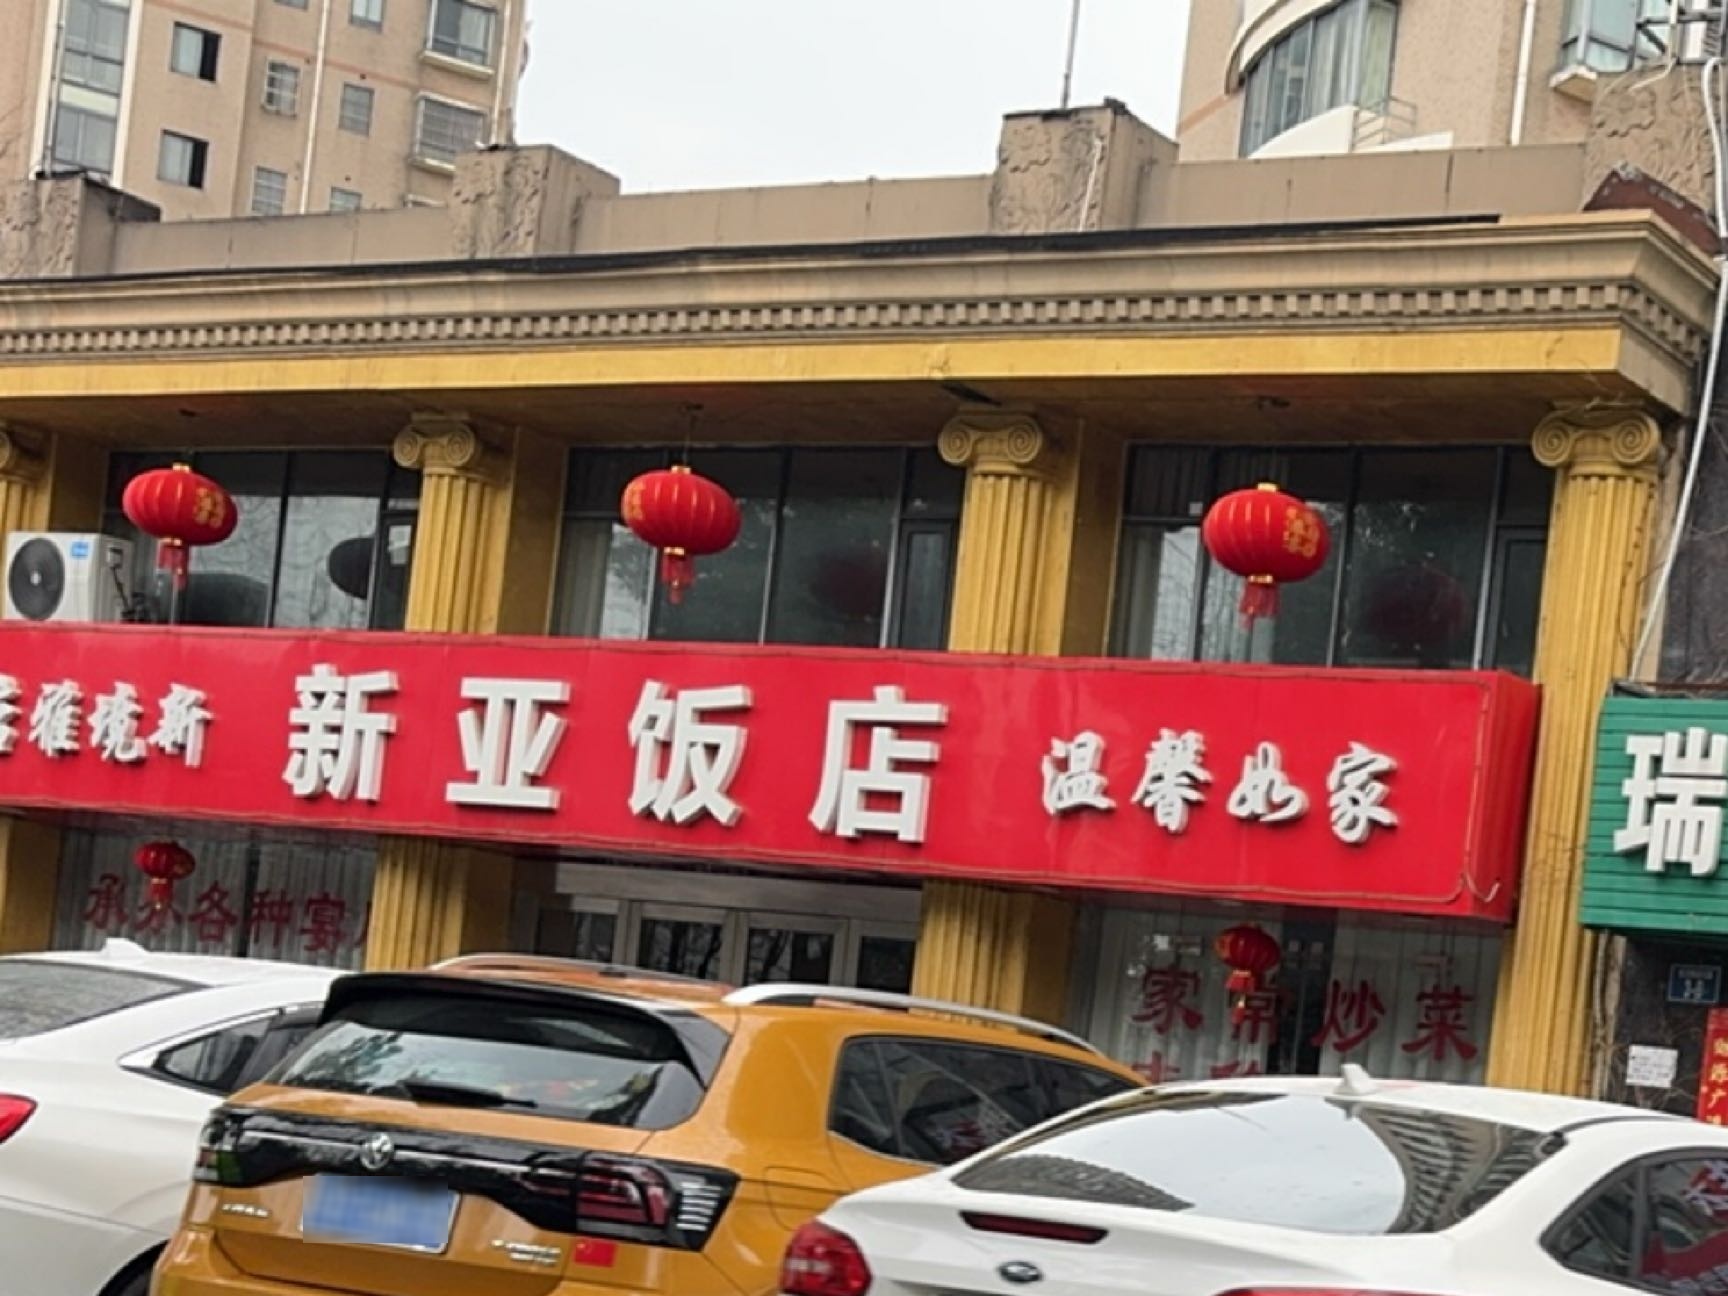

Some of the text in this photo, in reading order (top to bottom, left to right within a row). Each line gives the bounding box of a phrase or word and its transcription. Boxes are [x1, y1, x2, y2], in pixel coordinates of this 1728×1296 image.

[282, 663, 949, 843] 新亚饭店
[1042, 727, 1399, 845] 温馨如家
[1111, 963, 1479, 1062] 家常炒菜
